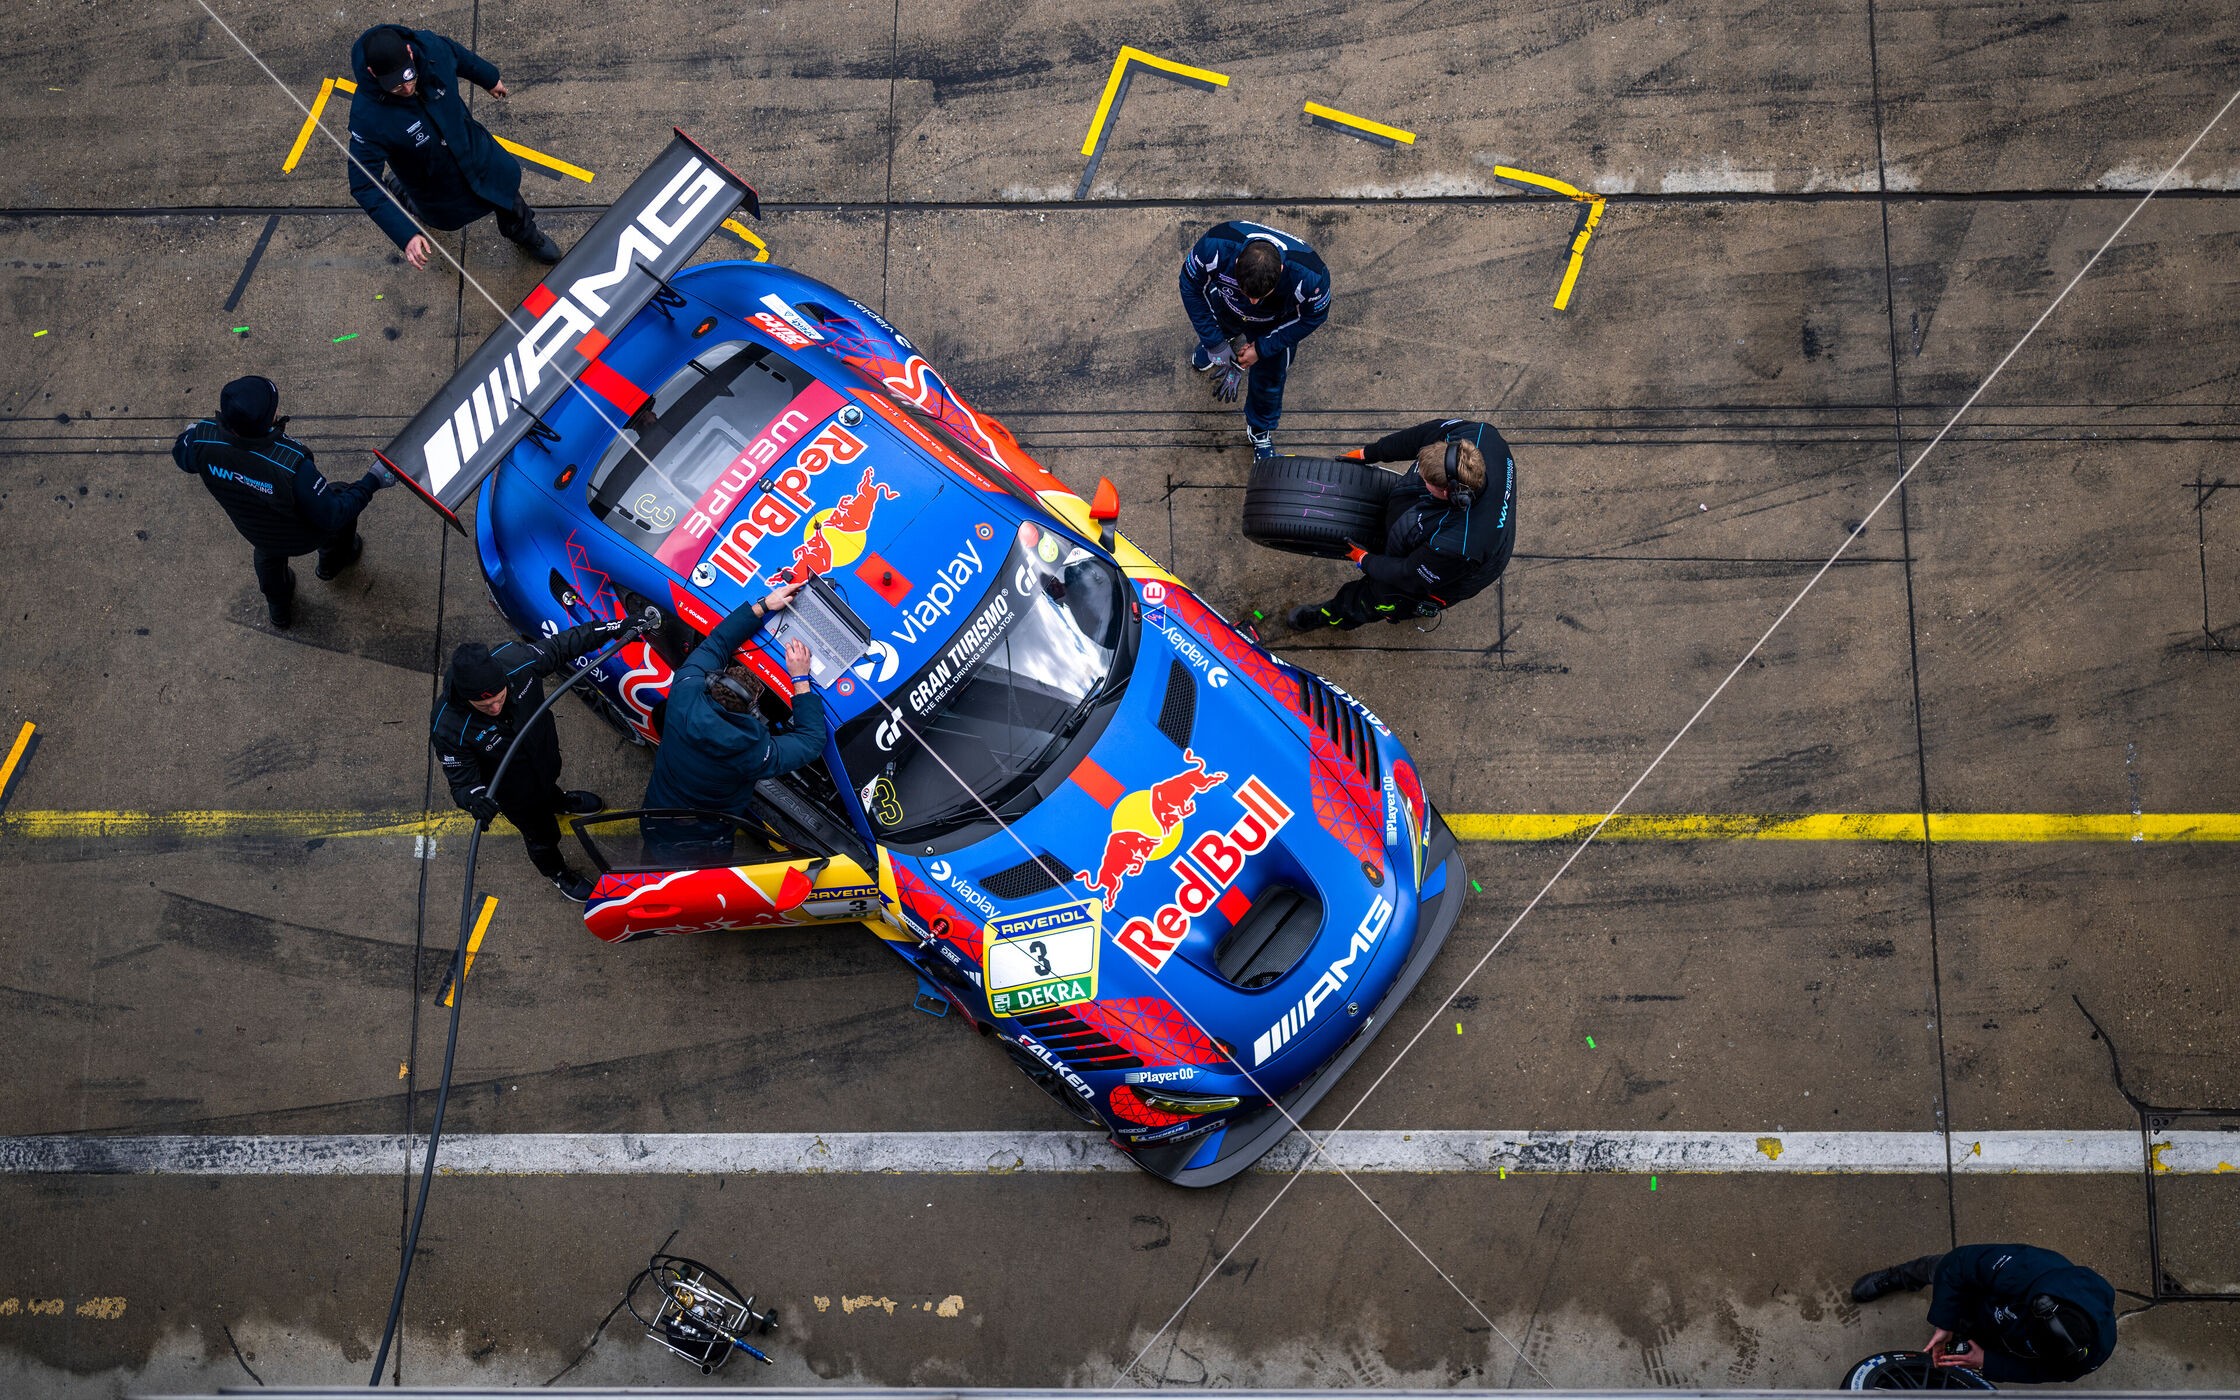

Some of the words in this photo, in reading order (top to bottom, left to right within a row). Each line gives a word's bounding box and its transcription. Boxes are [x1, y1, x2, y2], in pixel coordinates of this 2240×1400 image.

[517, 156, 727, 396] AMG
[754, 312, 810, 345] auto
[848, 299, 895, 334] viaplay
[683, 409, 809, 540] WEMPE
[773, 423, 865, 511] Red
[633, 494, 676, 528] 3
[710, 494, 798, 585] Bull
[890, 538, 983, 645] viaplay
[920, 700, 937, 717] THE
[935, 682, 955, 702] REAL
[953, 653, 981, 684] DRIVING
[979, 611, 1016, 655] SIMULATOR
[1161, 626, 1210, 672] viaplay
[909, 659, 952, 713] GRAN
[1316, 676, 1392, 737] FALKEN
[872, 777, 904, 826] 3
[1386, 791, 1399, 832] Player
[950, 875, 1002, 919] viaplay
[1116, 859, 1217, 971] Red
[1190, 777, 1291, 886] Bull
[848, 900, 868, 912] 3
[1000, 909, 1085, 935] RAVENOL
[940, 945, 962, 966] OMP
[1029, 940, 1052, 977] 3
[1304, 892, 1394, 1023] AMG
[1017, 980, 1087, 1009] DEKRA
[1018, 1034, 1096, 1099] FALKEN
[1139, 1071, 1179, 1085] Player
